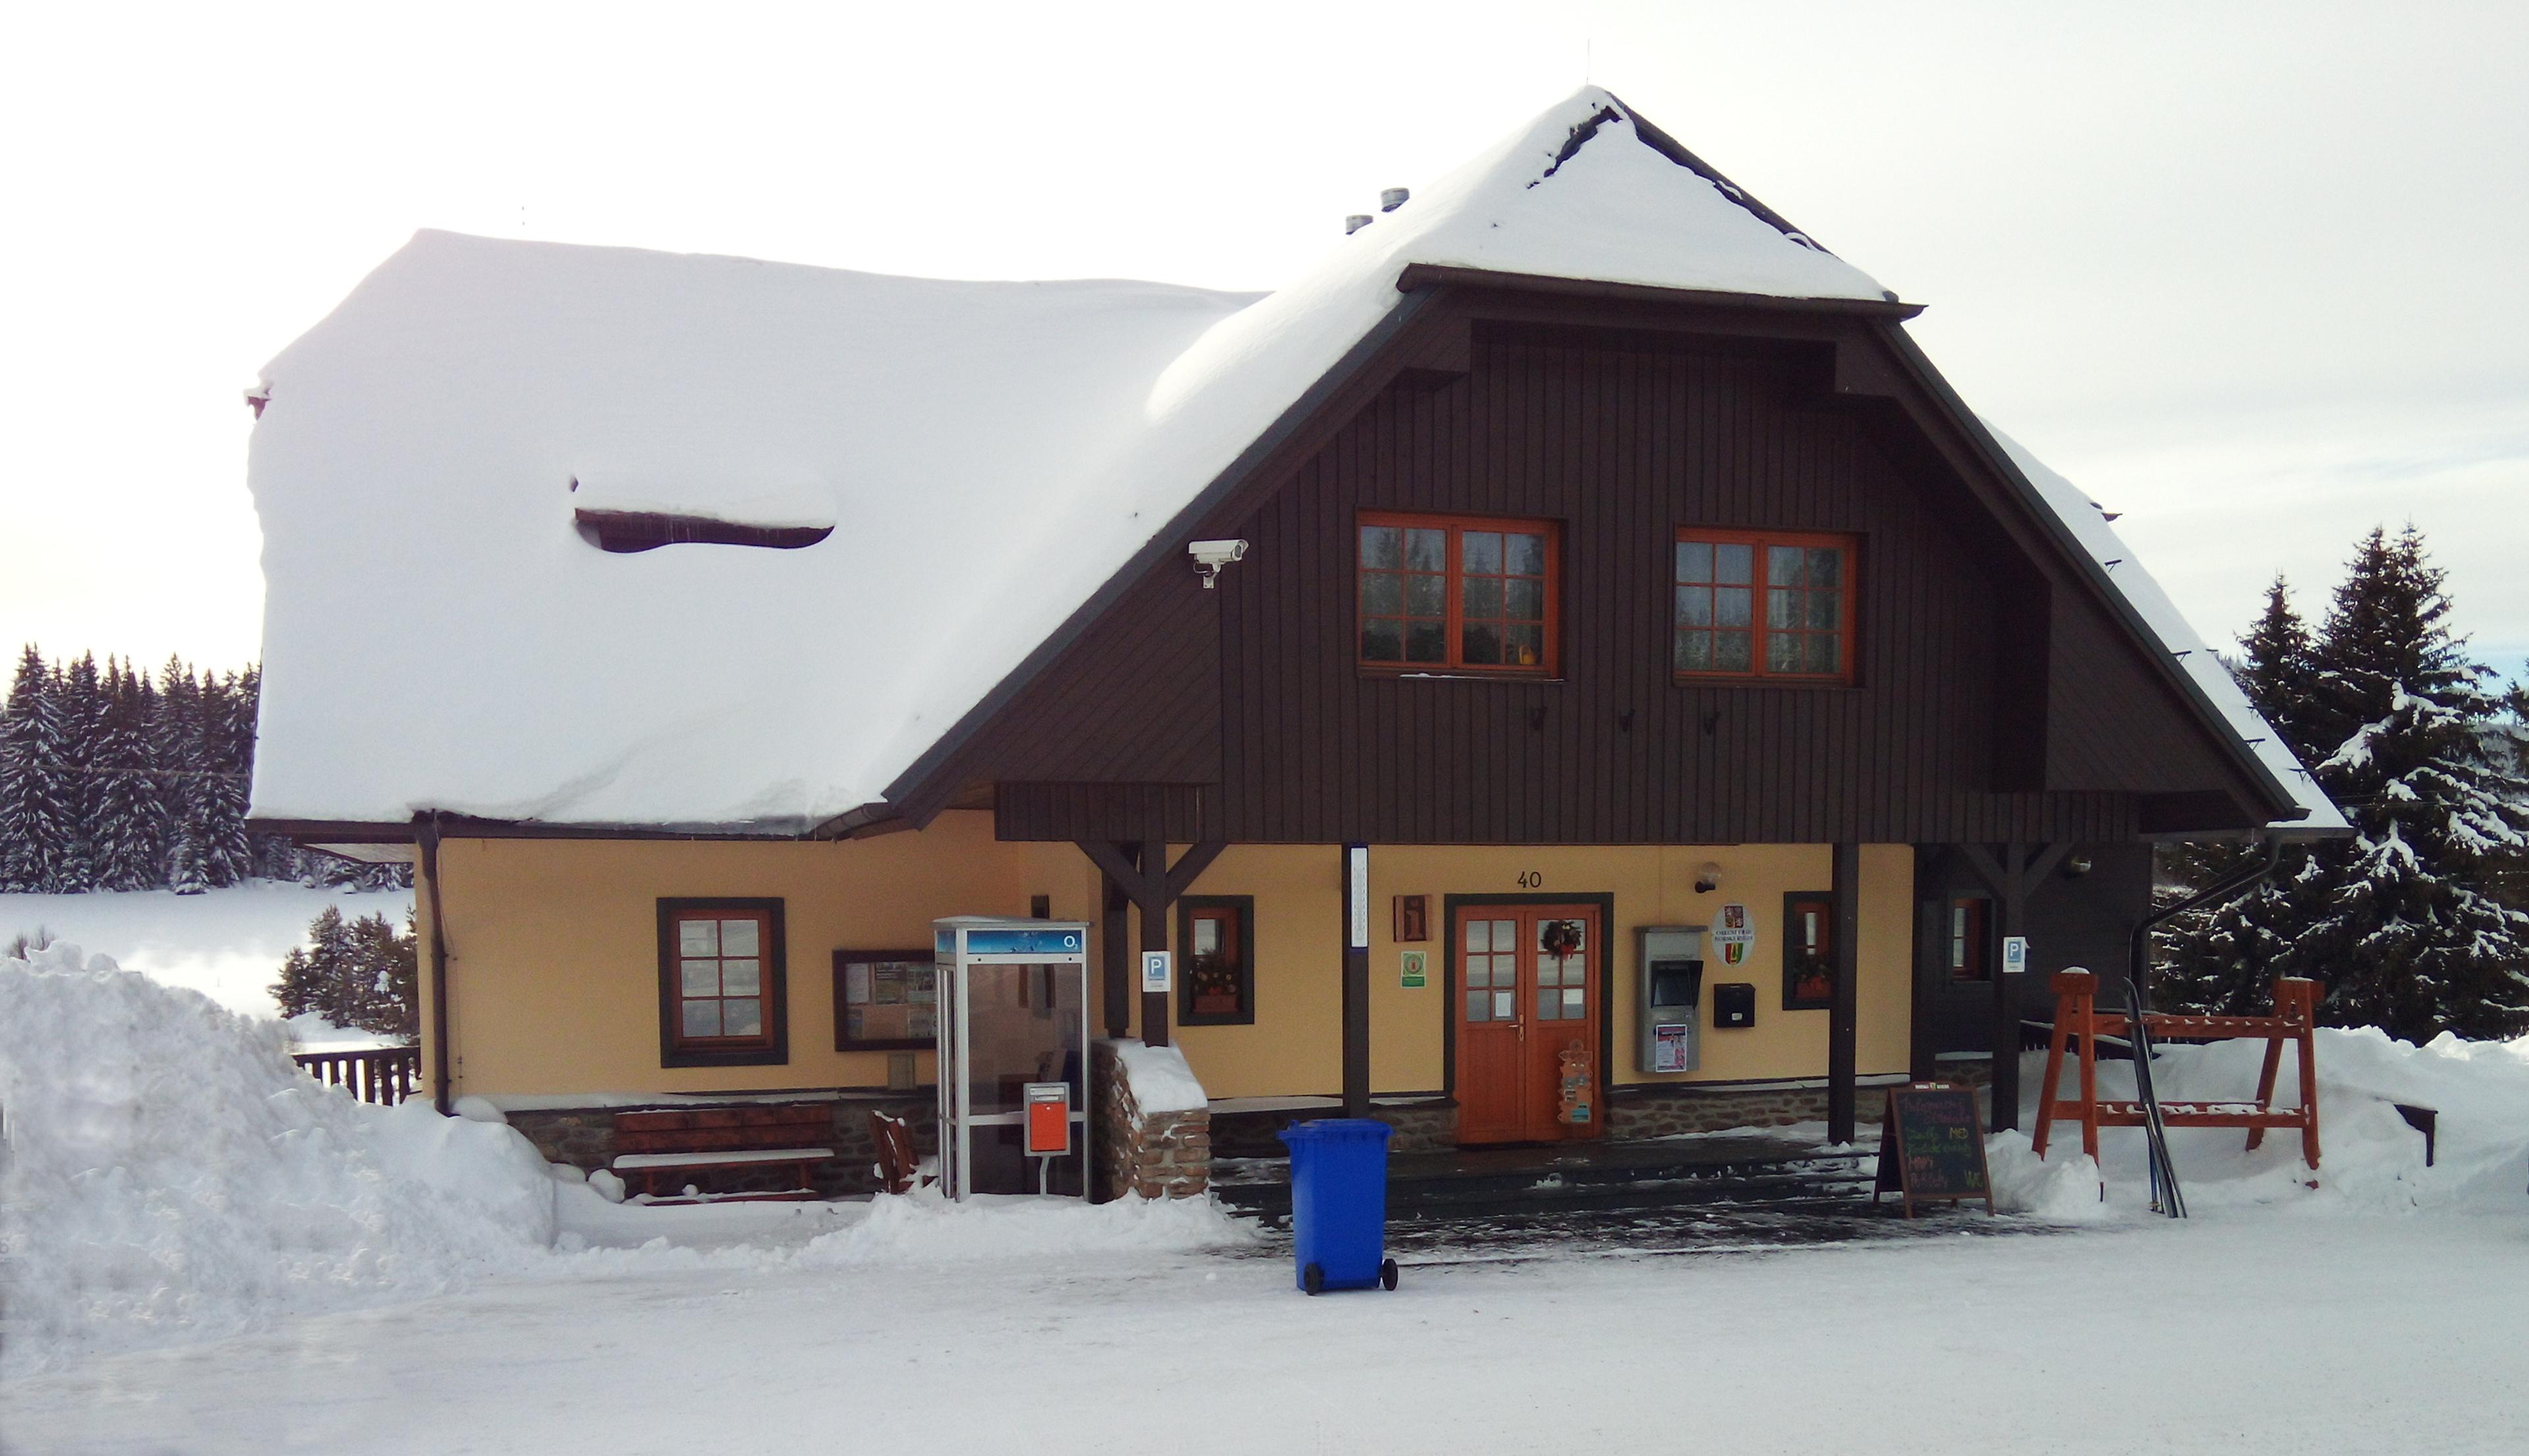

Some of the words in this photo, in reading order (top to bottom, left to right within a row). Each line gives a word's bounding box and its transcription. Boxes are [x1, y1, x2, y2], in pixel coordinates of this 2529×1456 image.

[1518, 871, 1541, 888] 40
[1064, 936, 1078, 949] O2
[2010, 943, 2019, 957] P
[1151, 959, 1162, 974] P
